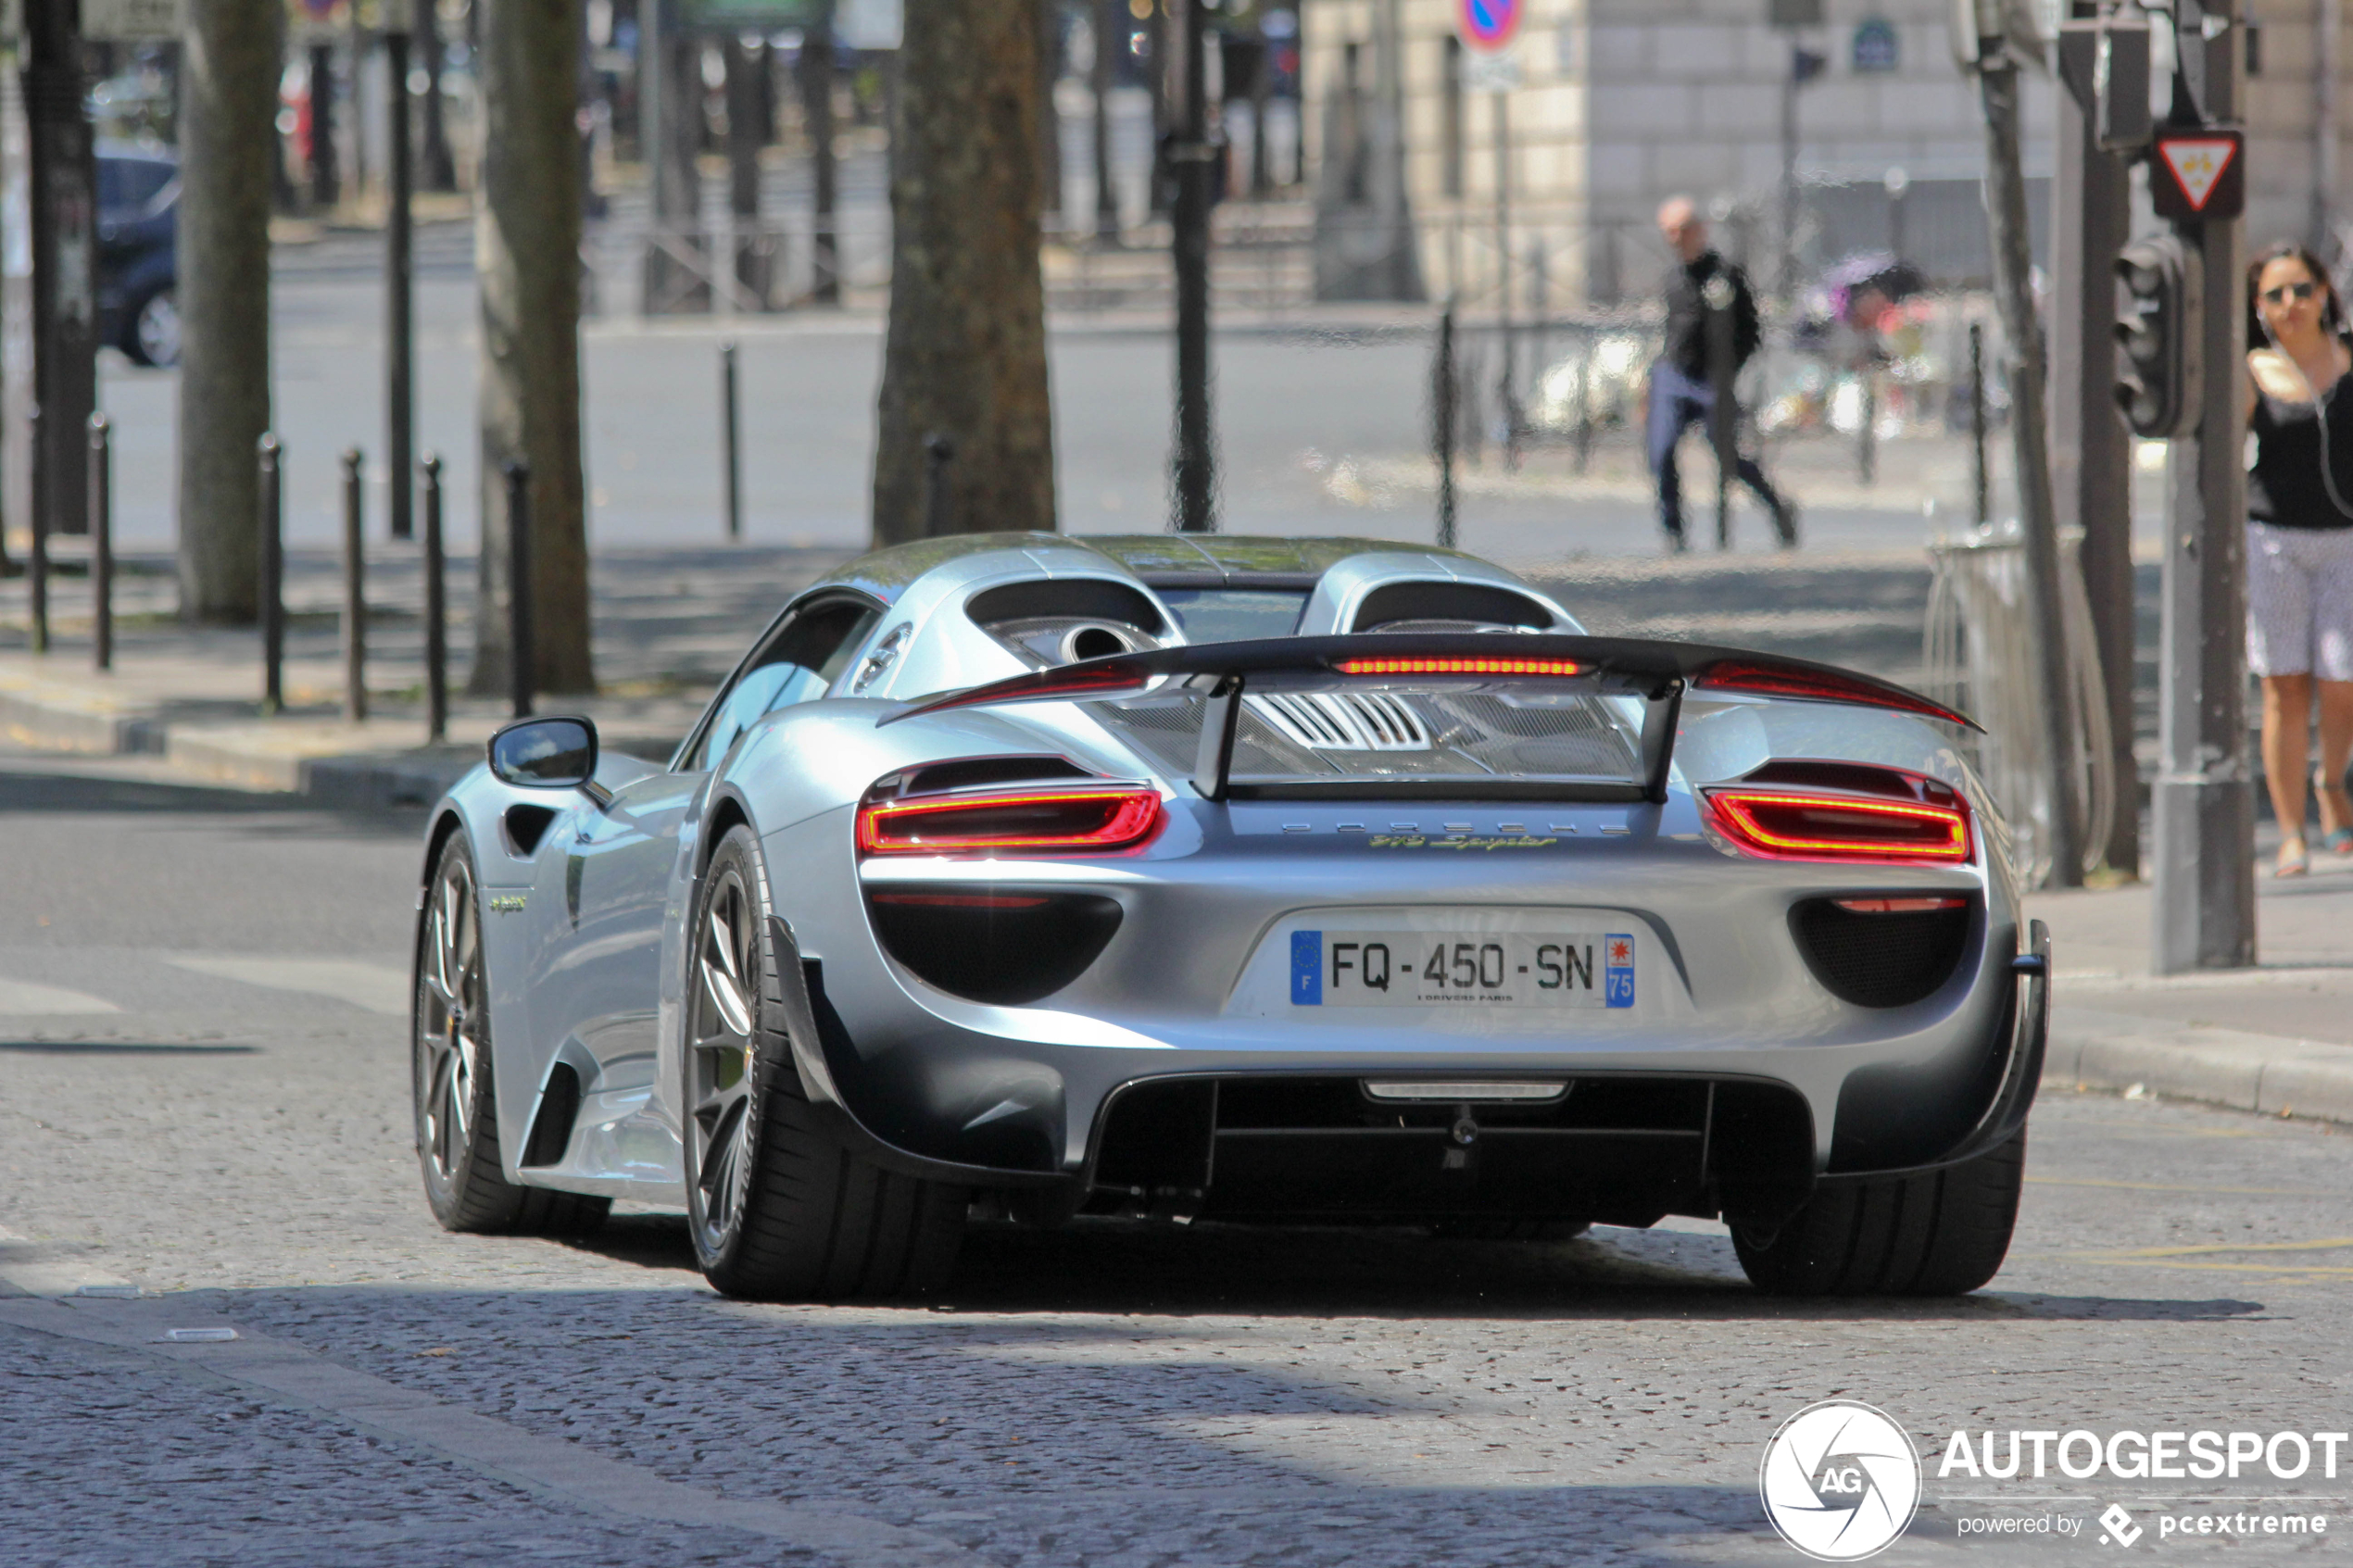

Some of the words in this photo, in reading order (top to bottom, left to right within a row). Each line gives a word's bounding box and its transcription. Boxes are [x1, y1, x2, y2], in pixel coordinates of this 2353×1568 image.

[1281, 822, 1631, 834] PORSCHE
[1429, 834, 1557, 850] Spyder
[1302, 975, 1312, 990] F
[1608, 973, 1632, 1000] 75
